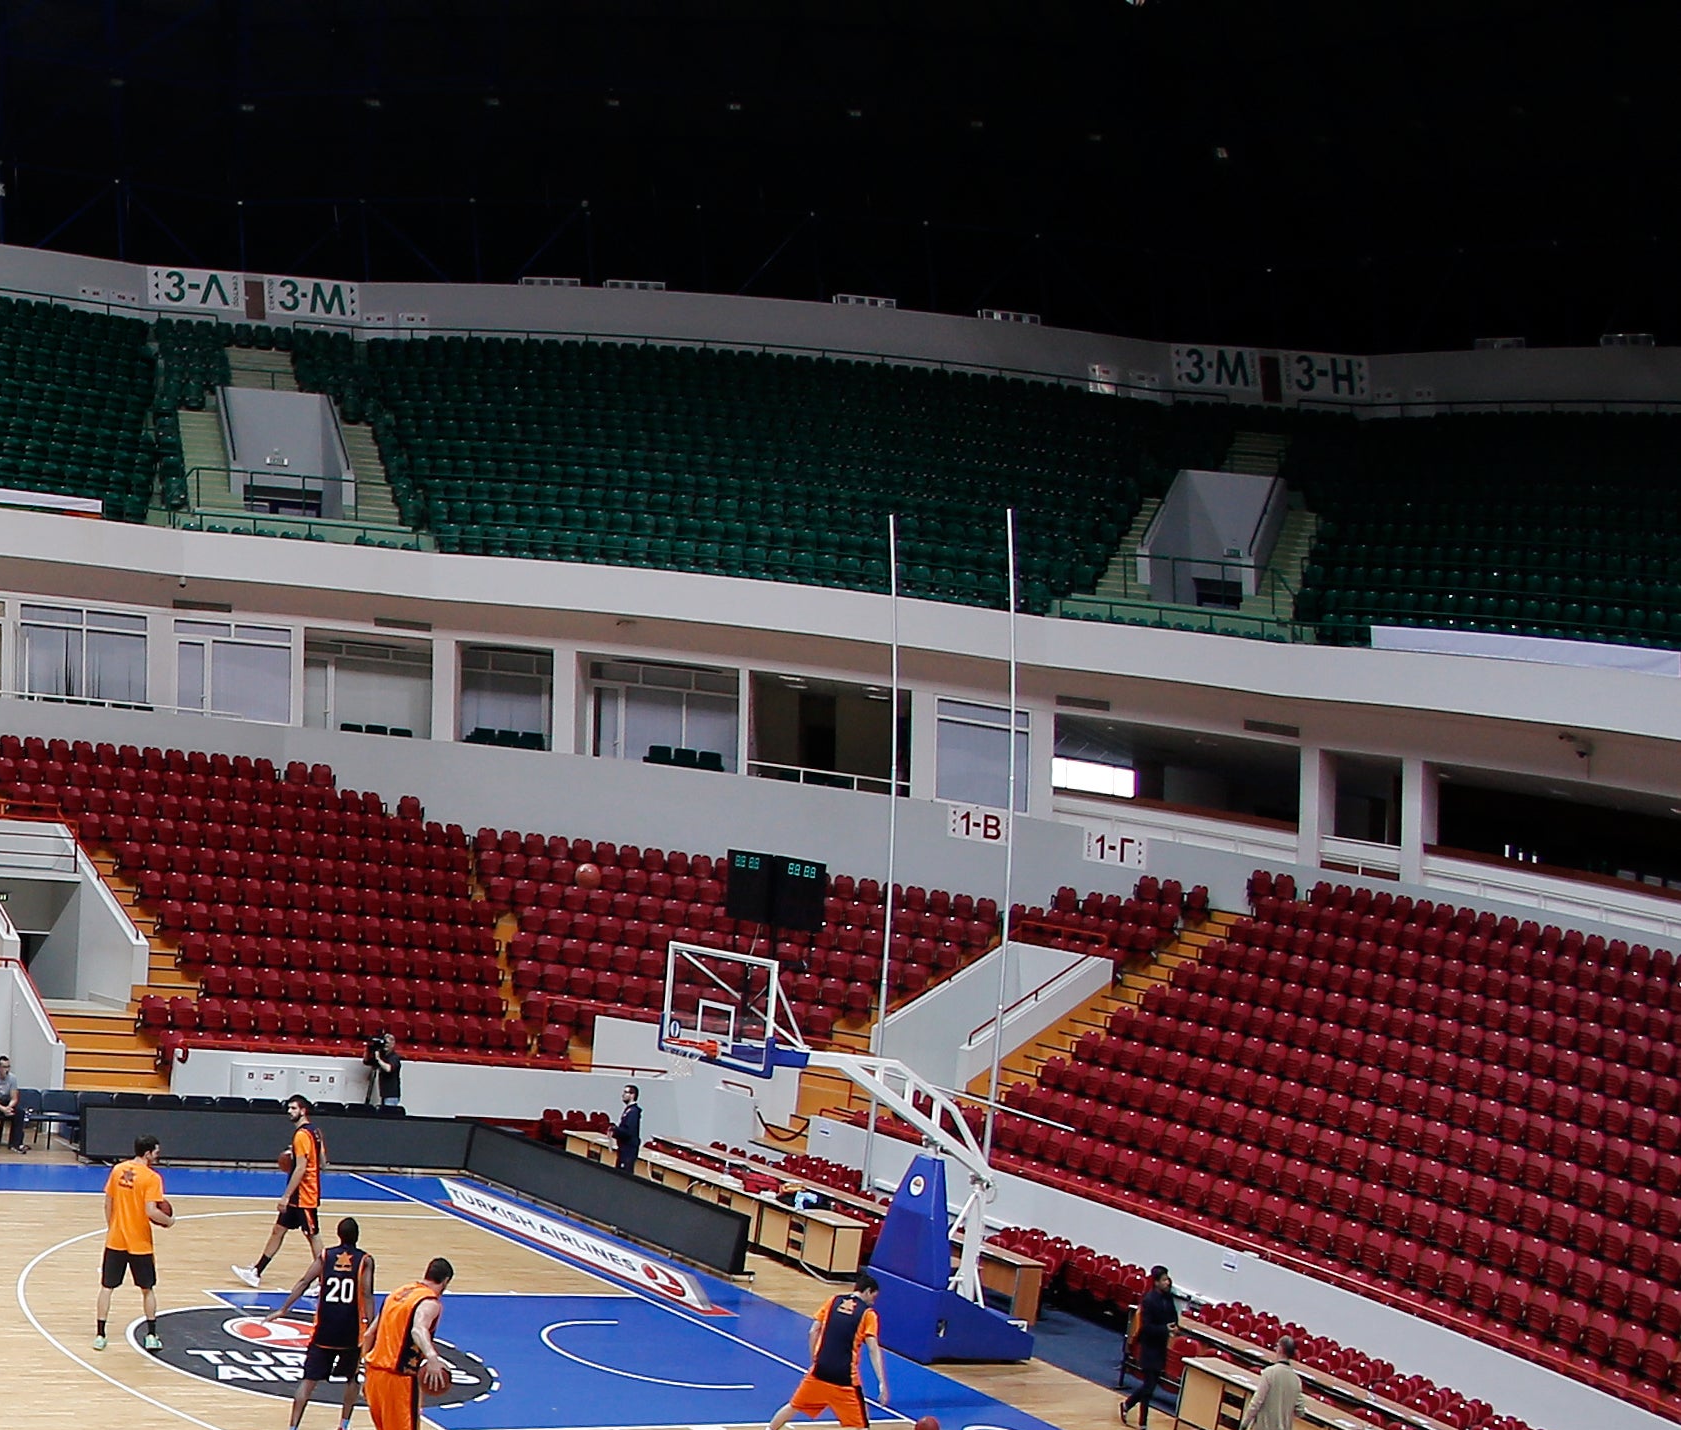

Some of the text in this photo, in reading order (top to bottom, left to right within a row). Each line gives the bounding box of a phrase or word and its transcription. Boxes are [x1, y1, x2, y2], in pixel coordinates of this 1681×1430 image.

[164, 270, 230, 306] 3-Л
[1295, 355, 1355, 395] 3-Н
[960, 810, 1002, 841] 1-В
[1095, 833, 1135, 863] 1-Г
[449, 1188, 637, 1272] TURKISH AIRLINES
[326, 1277, 355, 1304] 20
